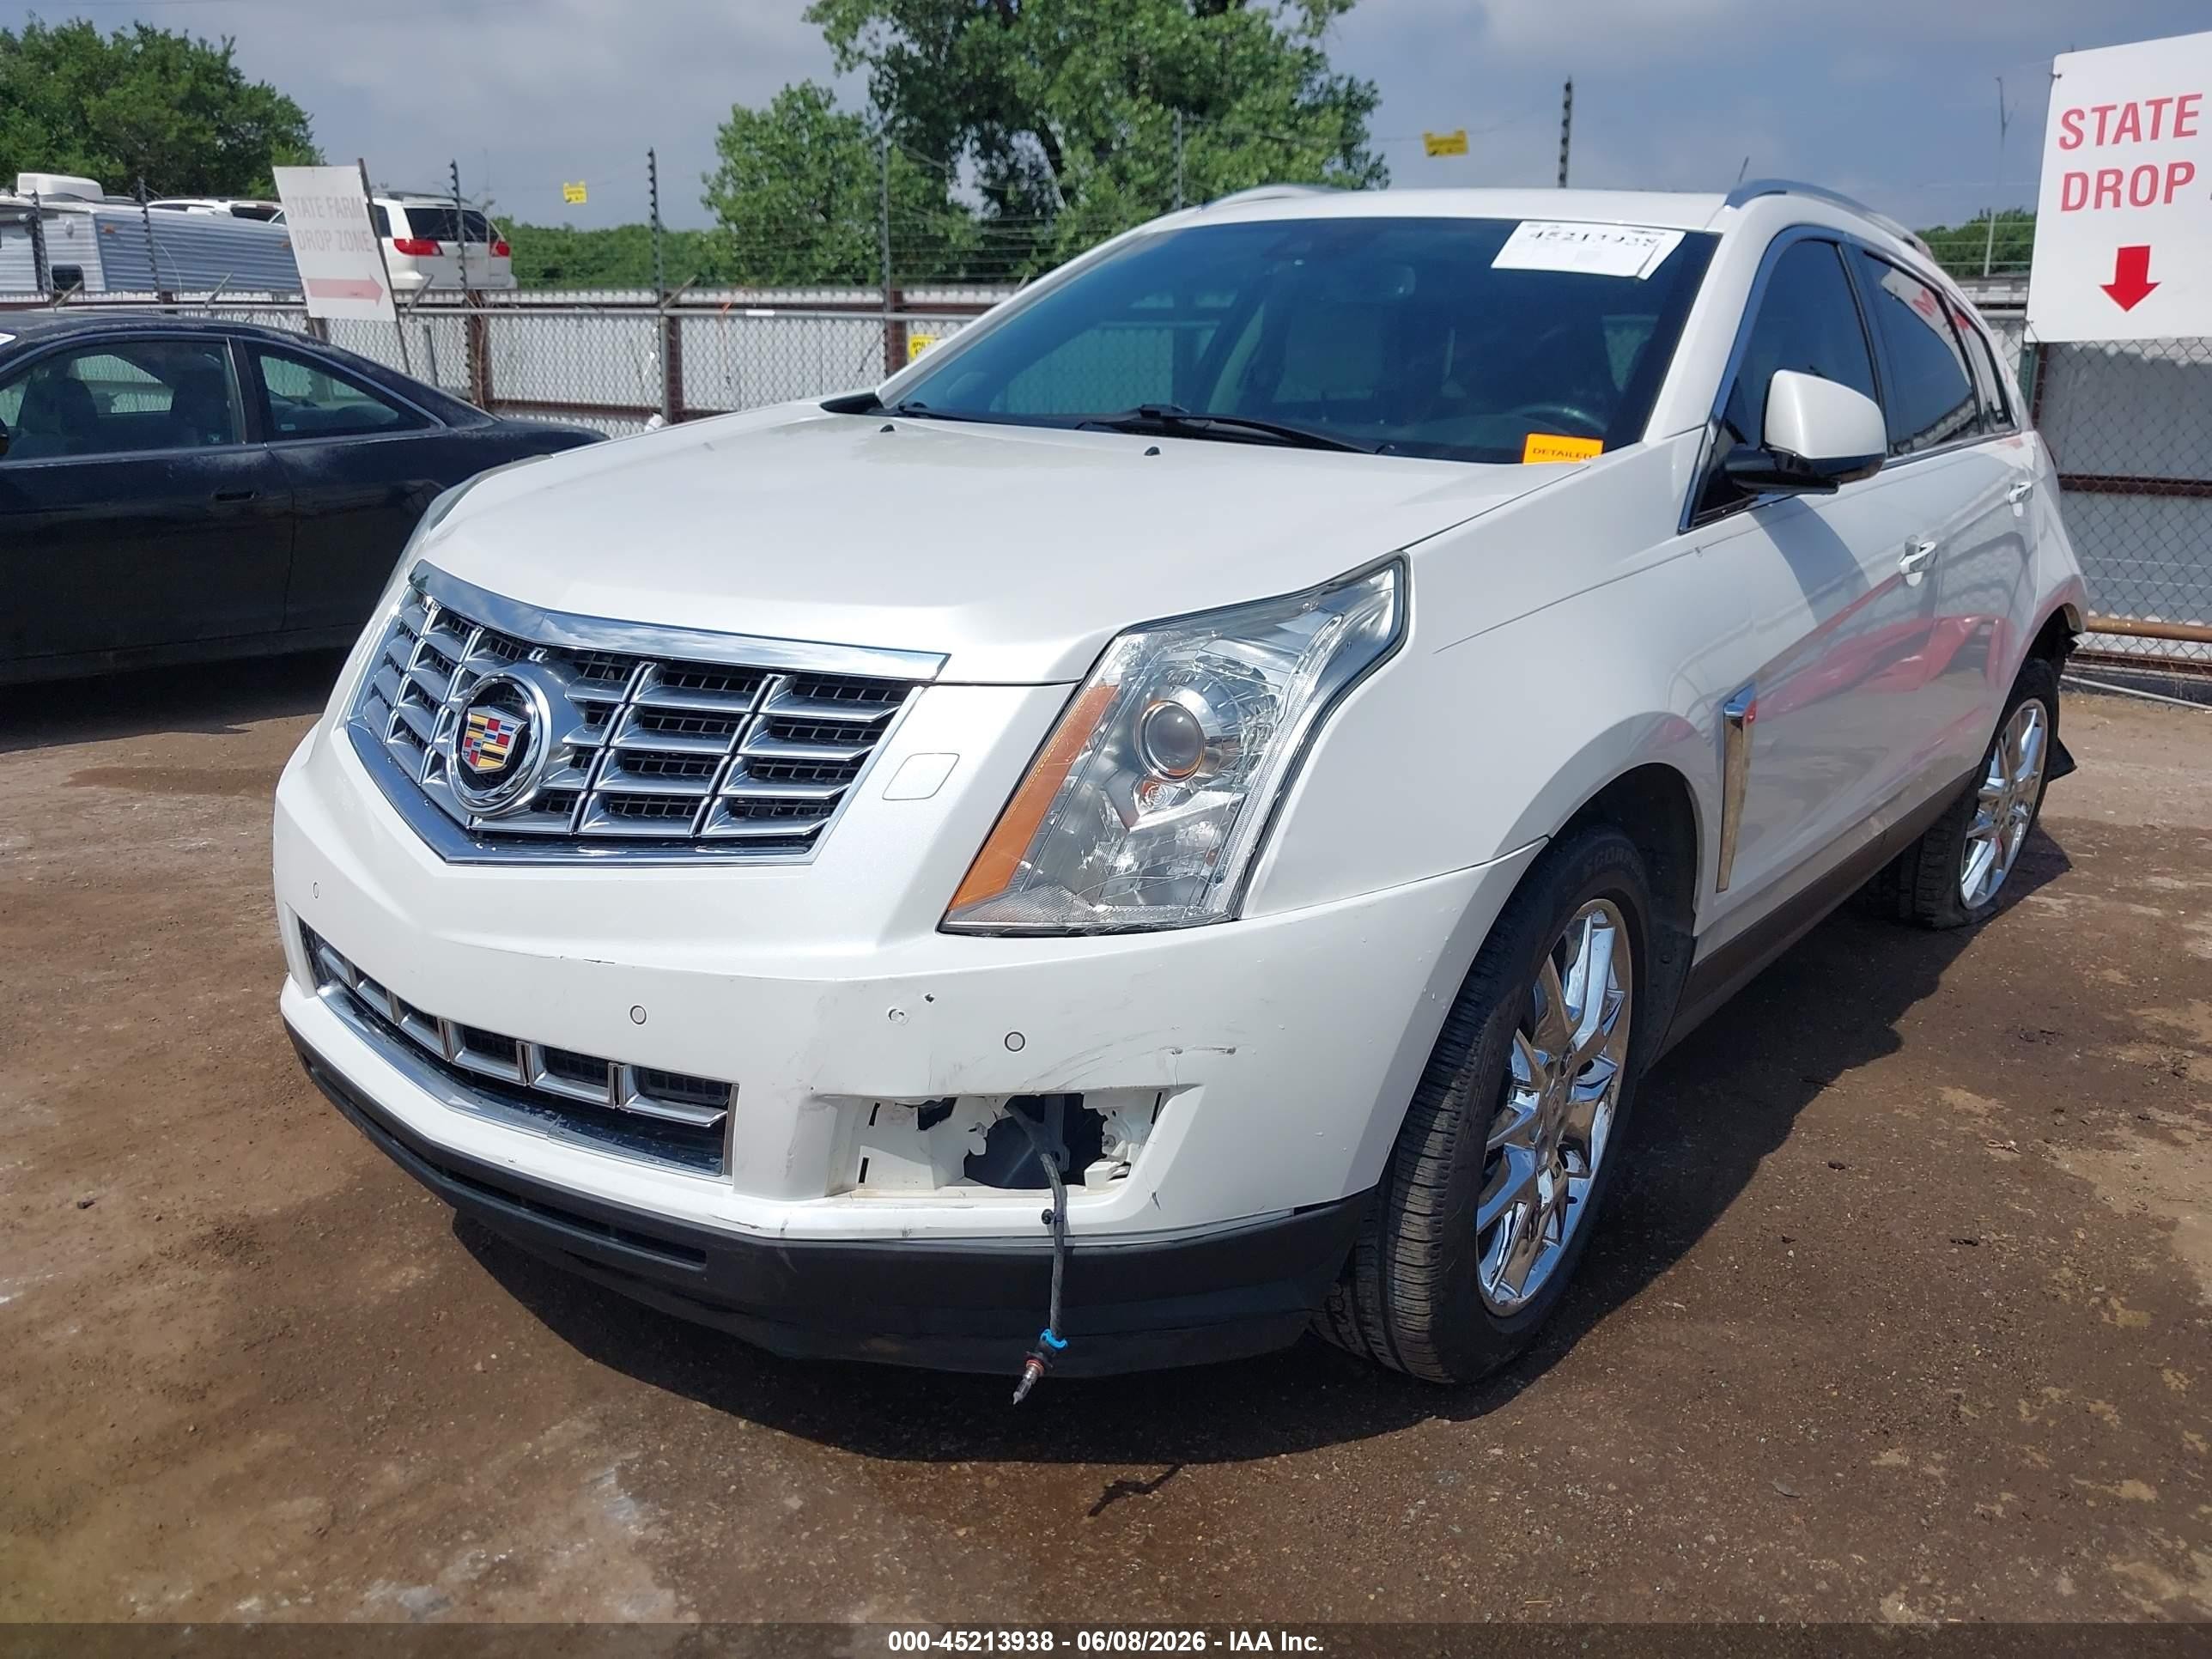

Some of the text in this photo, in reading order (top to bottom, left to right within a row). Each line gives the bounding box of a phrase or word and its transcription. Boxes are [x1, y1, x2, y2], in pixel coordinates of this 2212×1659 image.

[2058, 93, 2203, 150] STATE
[2060, 161, 2196, 211] DROP
[285, 197, 366, 219] STATE FARM
[295, 229, 374, 252] DROP ZONE
